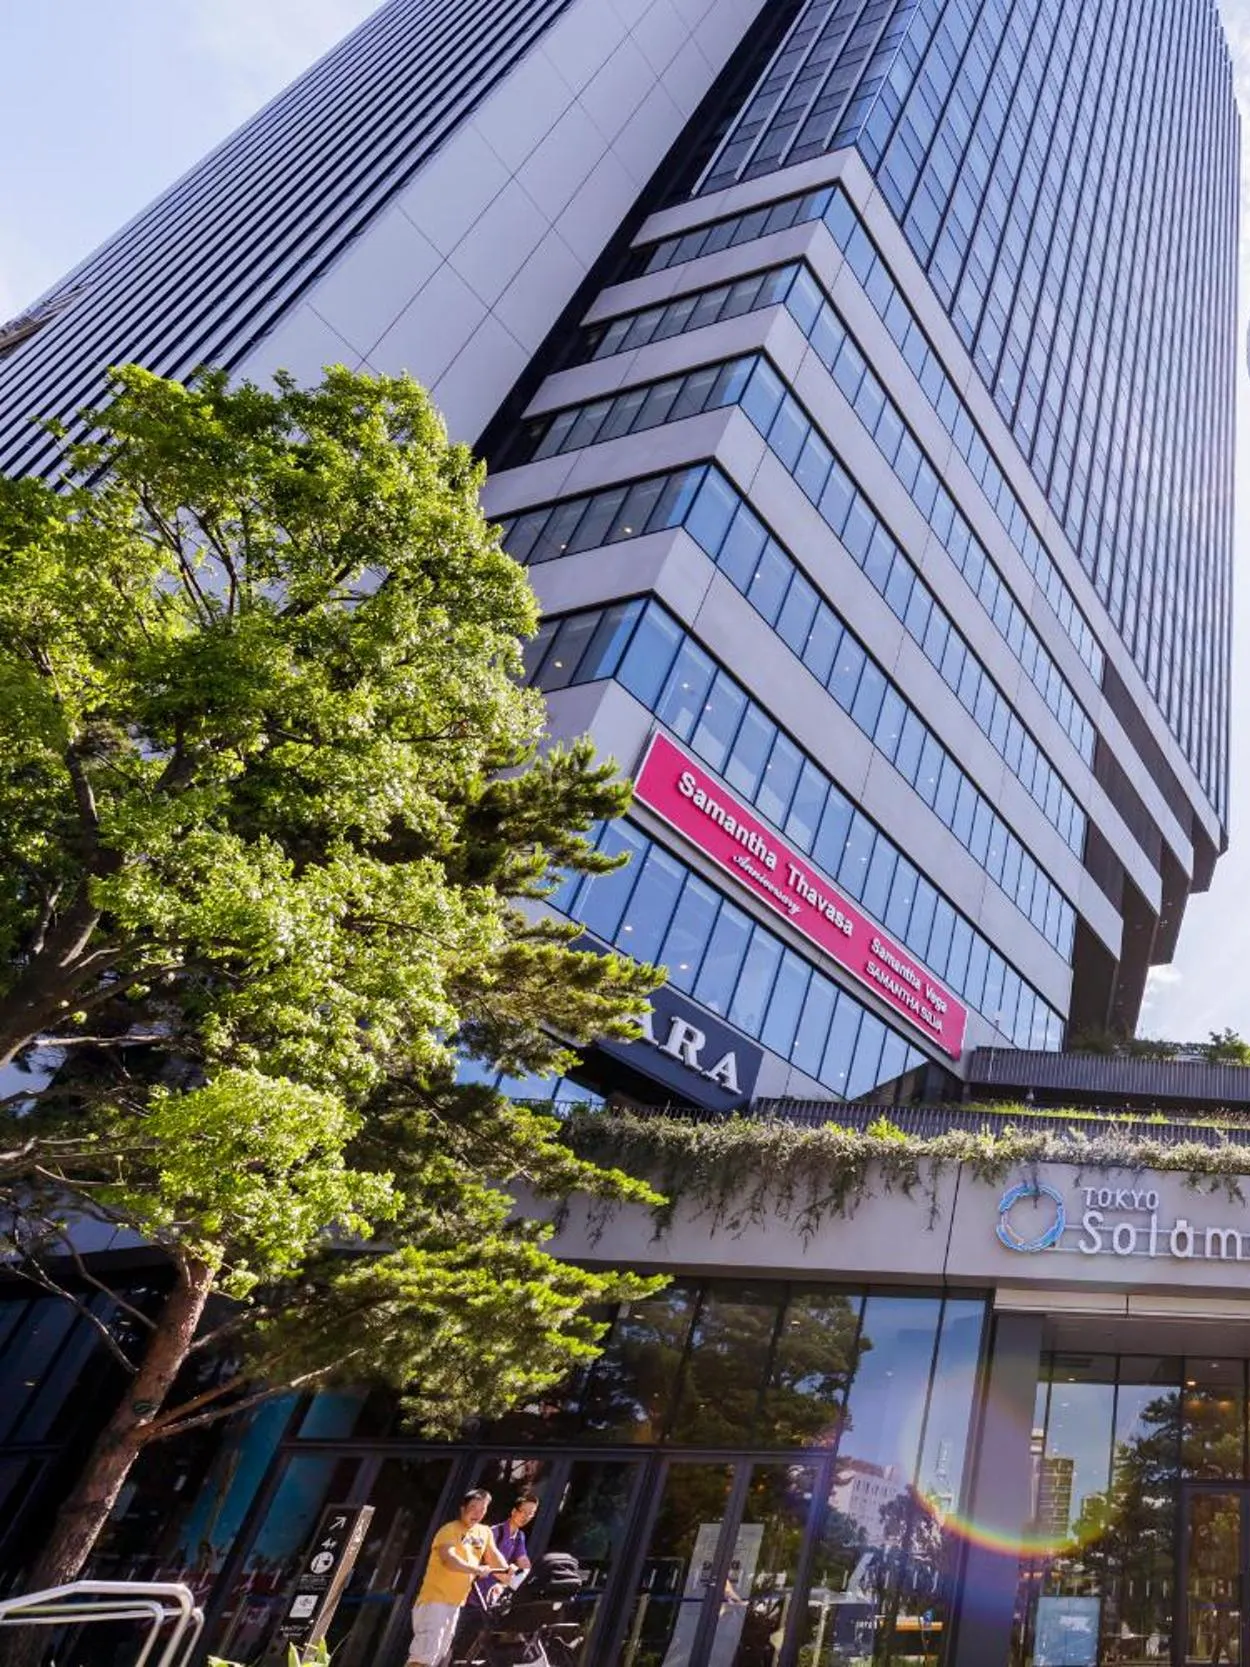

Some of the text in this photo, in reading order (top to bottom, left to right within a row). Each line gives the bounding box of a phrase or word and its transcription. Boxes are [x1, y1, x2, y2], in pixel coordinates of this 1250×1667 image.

[678, 771, 853, 936] Samantha Thavasa
[866, 961, 920, 1013] SAMANTHA
[871, 938, 921, 990] Samantha
[618, 998, 742, 1094] ARA
[1082, 1187, 1160, 1209] TOKYO
